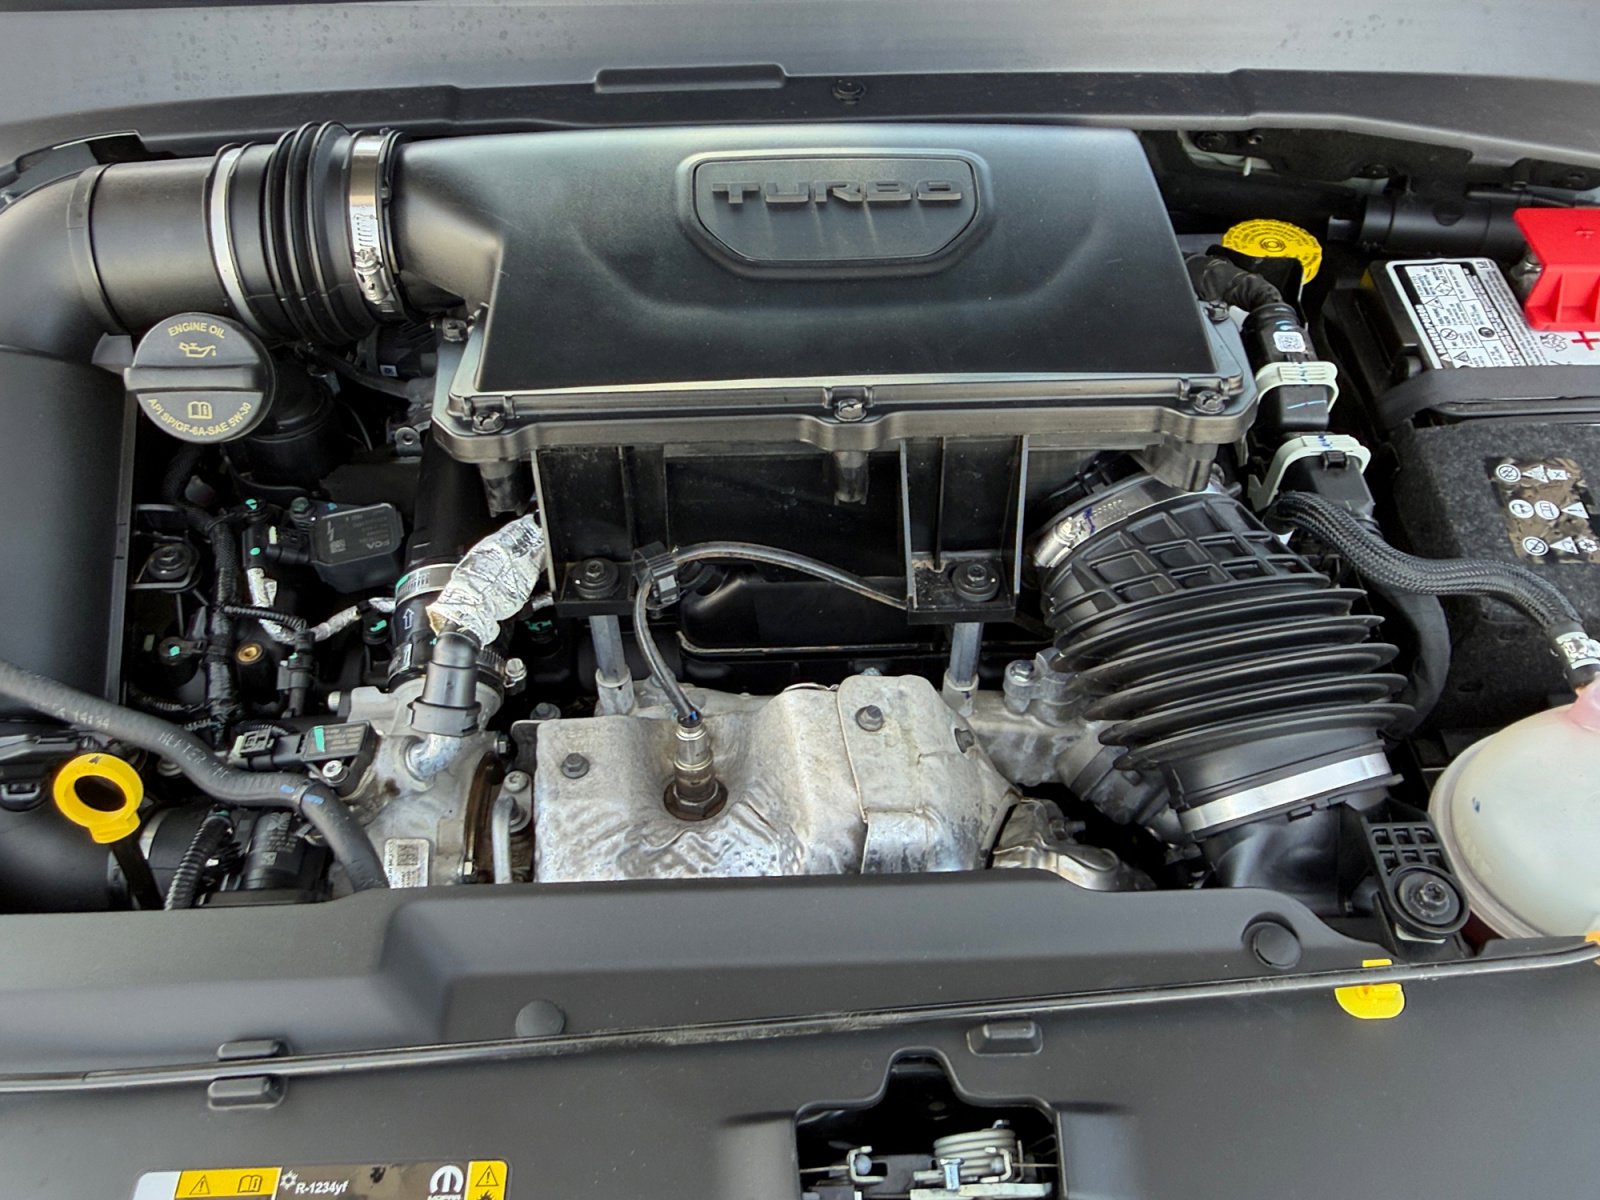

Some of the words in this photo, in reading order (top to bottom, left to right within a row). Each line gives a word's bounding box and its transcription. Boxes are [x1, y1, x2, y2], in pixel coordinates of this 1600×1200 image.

[712, 181, 962, 204] TURBO
[168, 322, 207, 336] ENGINE
[209, 325, 225, 338] OIL
[148, 399, 164, 415] API
[228, 402, 252, 427] 5W-30
[295, 1180, 349, 1195] R-1234yf
